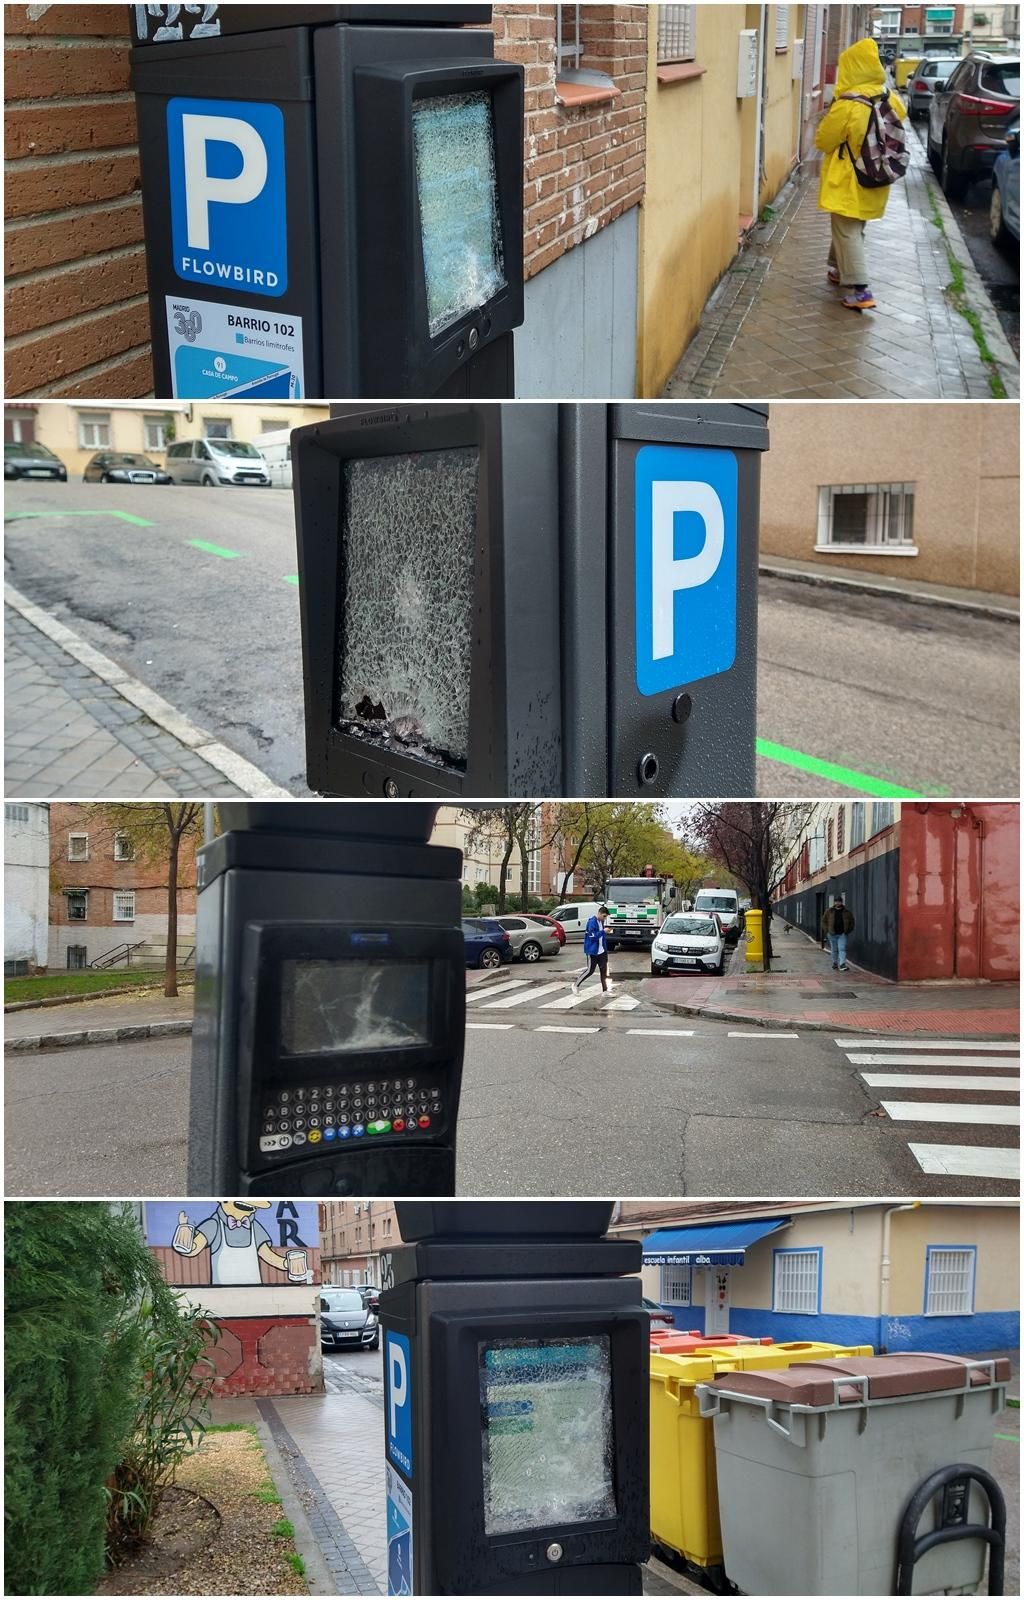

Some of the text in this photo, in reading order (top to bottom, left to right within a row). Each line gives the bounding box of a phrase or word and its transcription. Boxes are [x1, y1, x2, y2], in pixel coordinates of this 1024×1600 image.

[182, 113, 268, 251] P
[182, 256, 278, 287] FLOWBIRD
[172, 304, 190, 313] MADRID
[227, 314, 295, 337] BARRIO 102
[244, 336, 265, 347] Barrios
[202, 369, 239, 382] CASA DE CAMPO
[652, 480, 725, 661] P
[644, 1254, 711, 1265] escuela infantil alba
[388, 1340, 408, 1439] P
